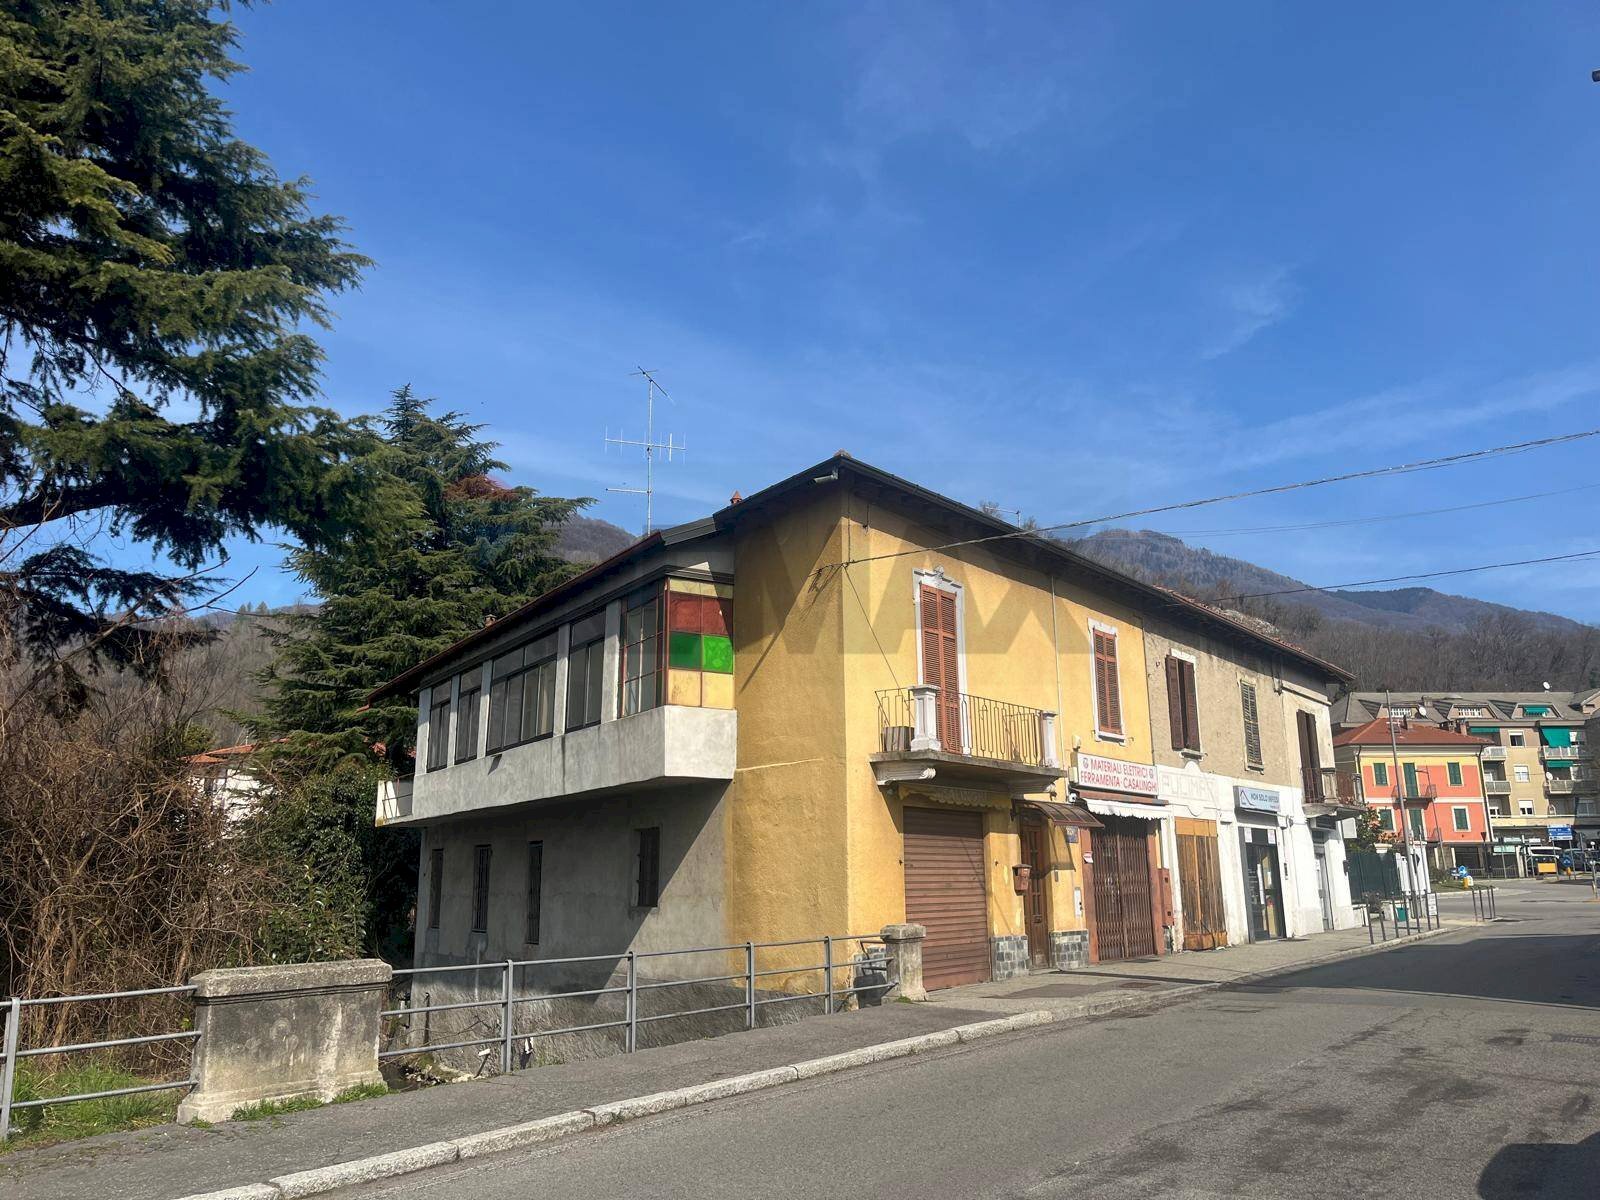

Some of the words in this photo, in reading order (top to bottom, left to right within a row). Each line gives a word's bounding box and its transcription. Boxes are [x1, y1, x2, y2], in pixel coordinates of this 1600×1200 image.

[1090, 758, 1122, 774] MATERIALI
[1123, 764, 1147, 778] ELETTRICI
[1080, 771, 1120, 787] FERRAMENTA
[1123, 777, 1157, 793] CASALINGHI
